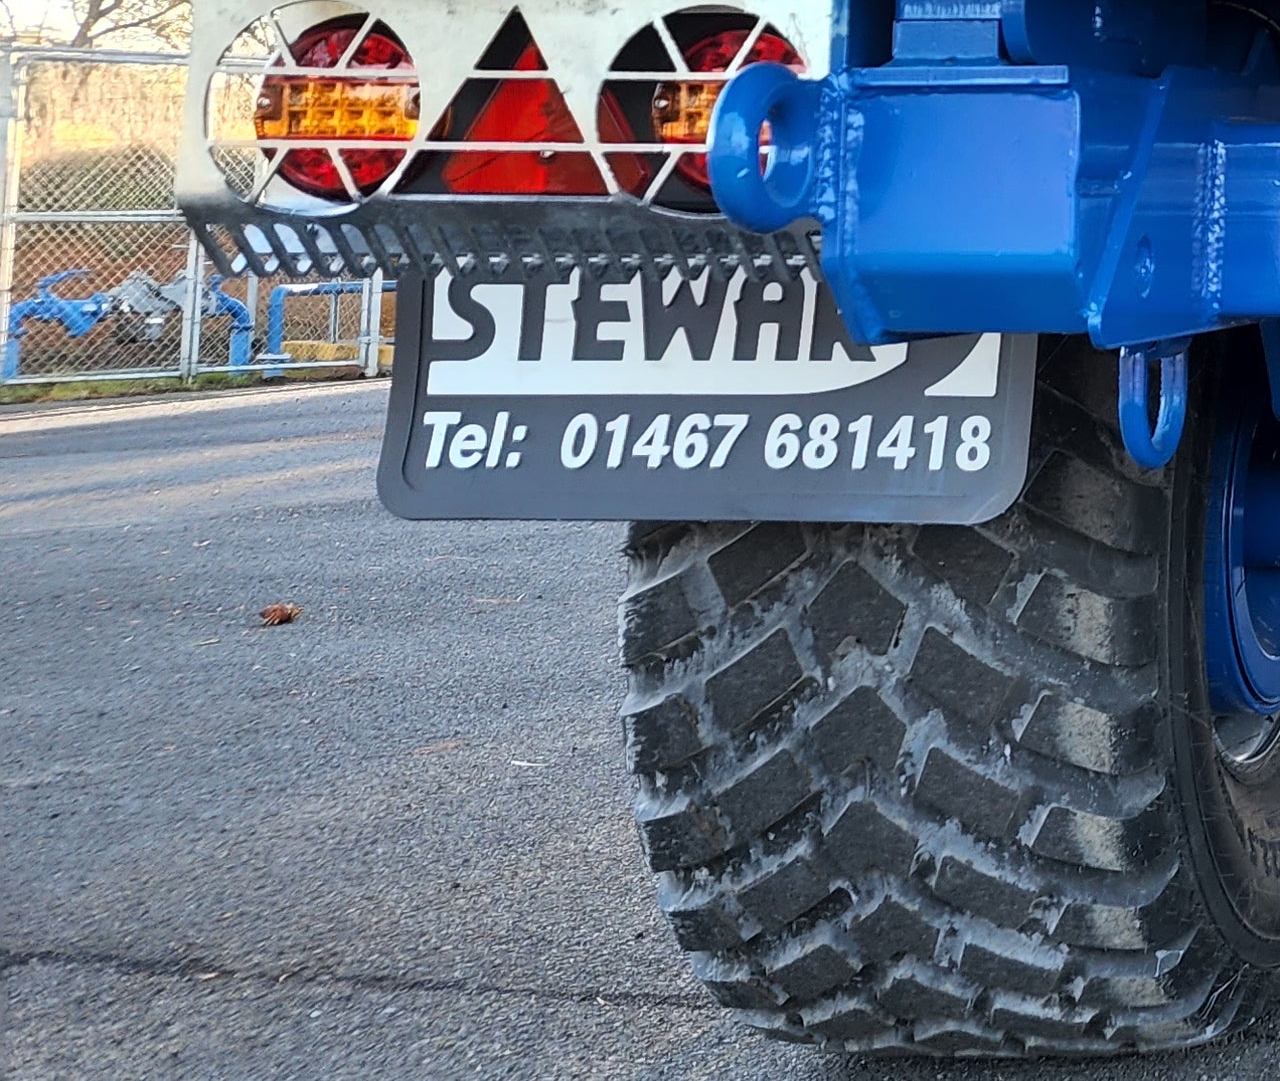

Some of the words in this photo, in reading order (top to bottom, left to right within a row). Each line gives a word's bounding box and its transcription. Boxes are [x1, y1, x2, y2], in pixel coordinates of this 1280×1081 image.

[421, 411, 526, 469] Tel:
[560, 413, 749, 470] 01467
[764, 414, 992, 472] 681418
